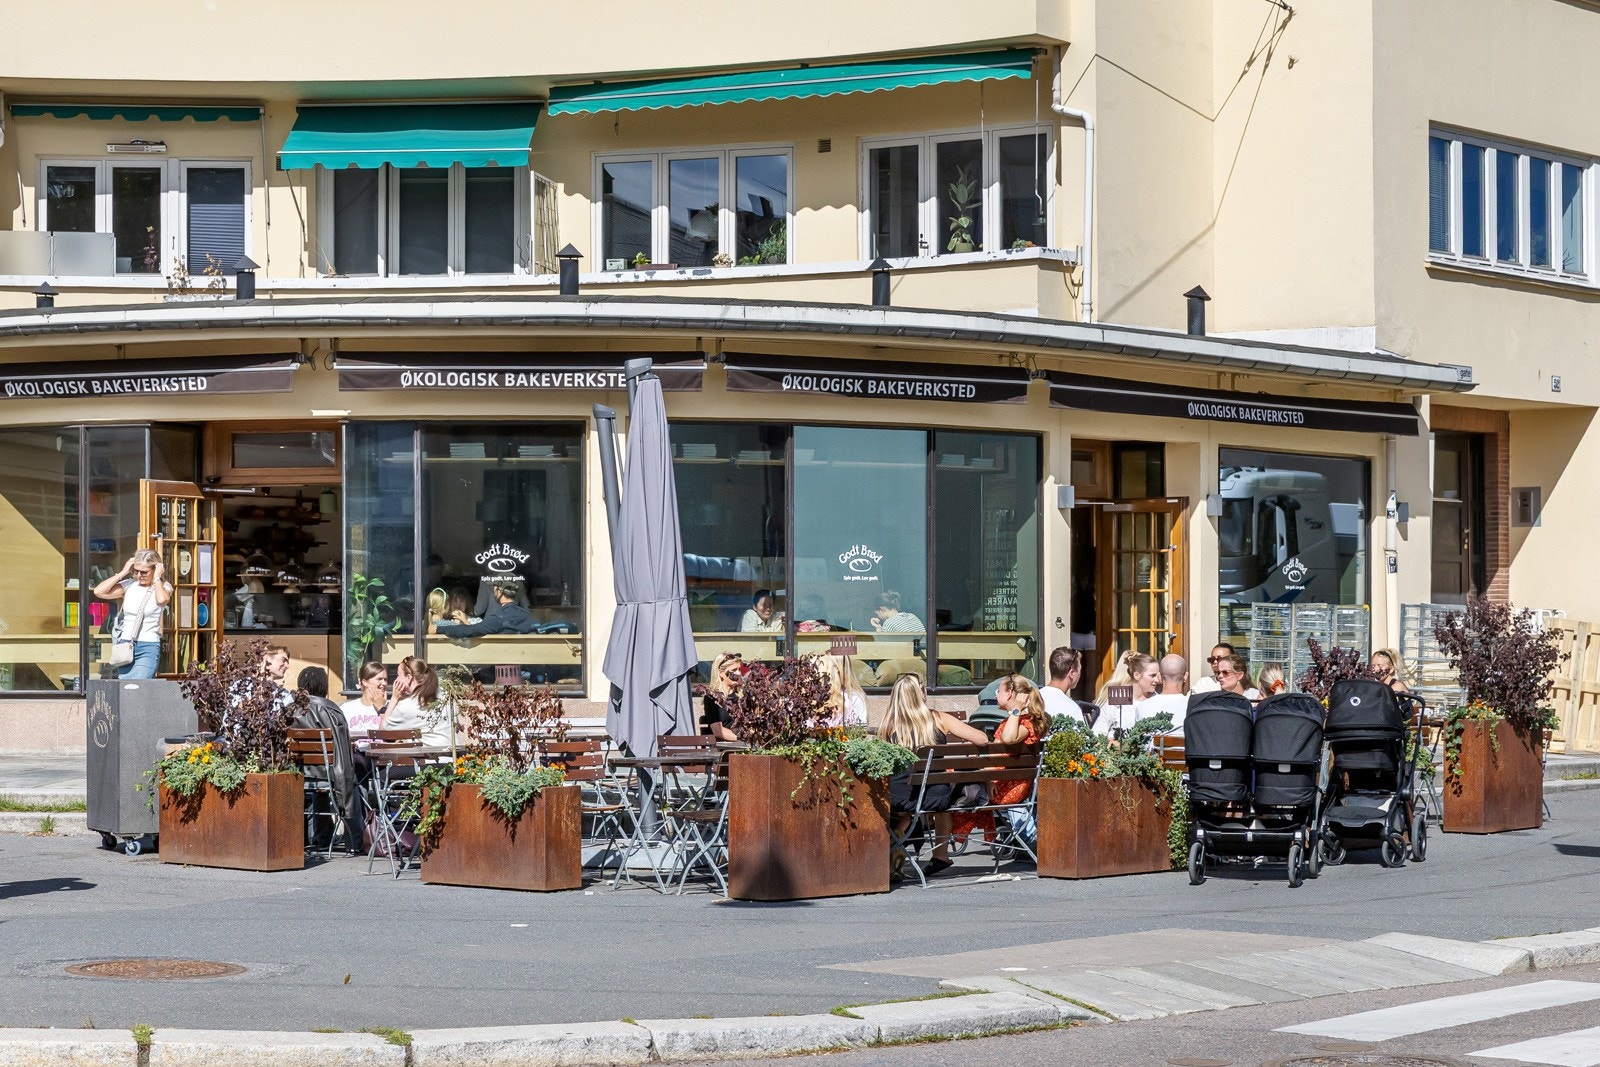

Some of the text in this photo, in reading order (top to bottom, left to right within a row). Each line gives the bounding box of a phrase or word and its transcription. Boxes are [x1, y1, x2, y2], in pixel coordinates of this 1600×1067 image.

[4, 376, 208, 398] ØKOLOGISK BAKEVERKSTED
[400, 371, 638, 388] ØKOLOGISK BAKEVERKSTE
[782, 374, 976, 398] ØKOLOGISK BAKEVERKSTED
[1188, 401, 1304, 424] ØKOLOGISK BAKEVERKSTED
[475, 544, 530, 564] Godt Brød
[838, 544, 883, 564] Godt Brød
